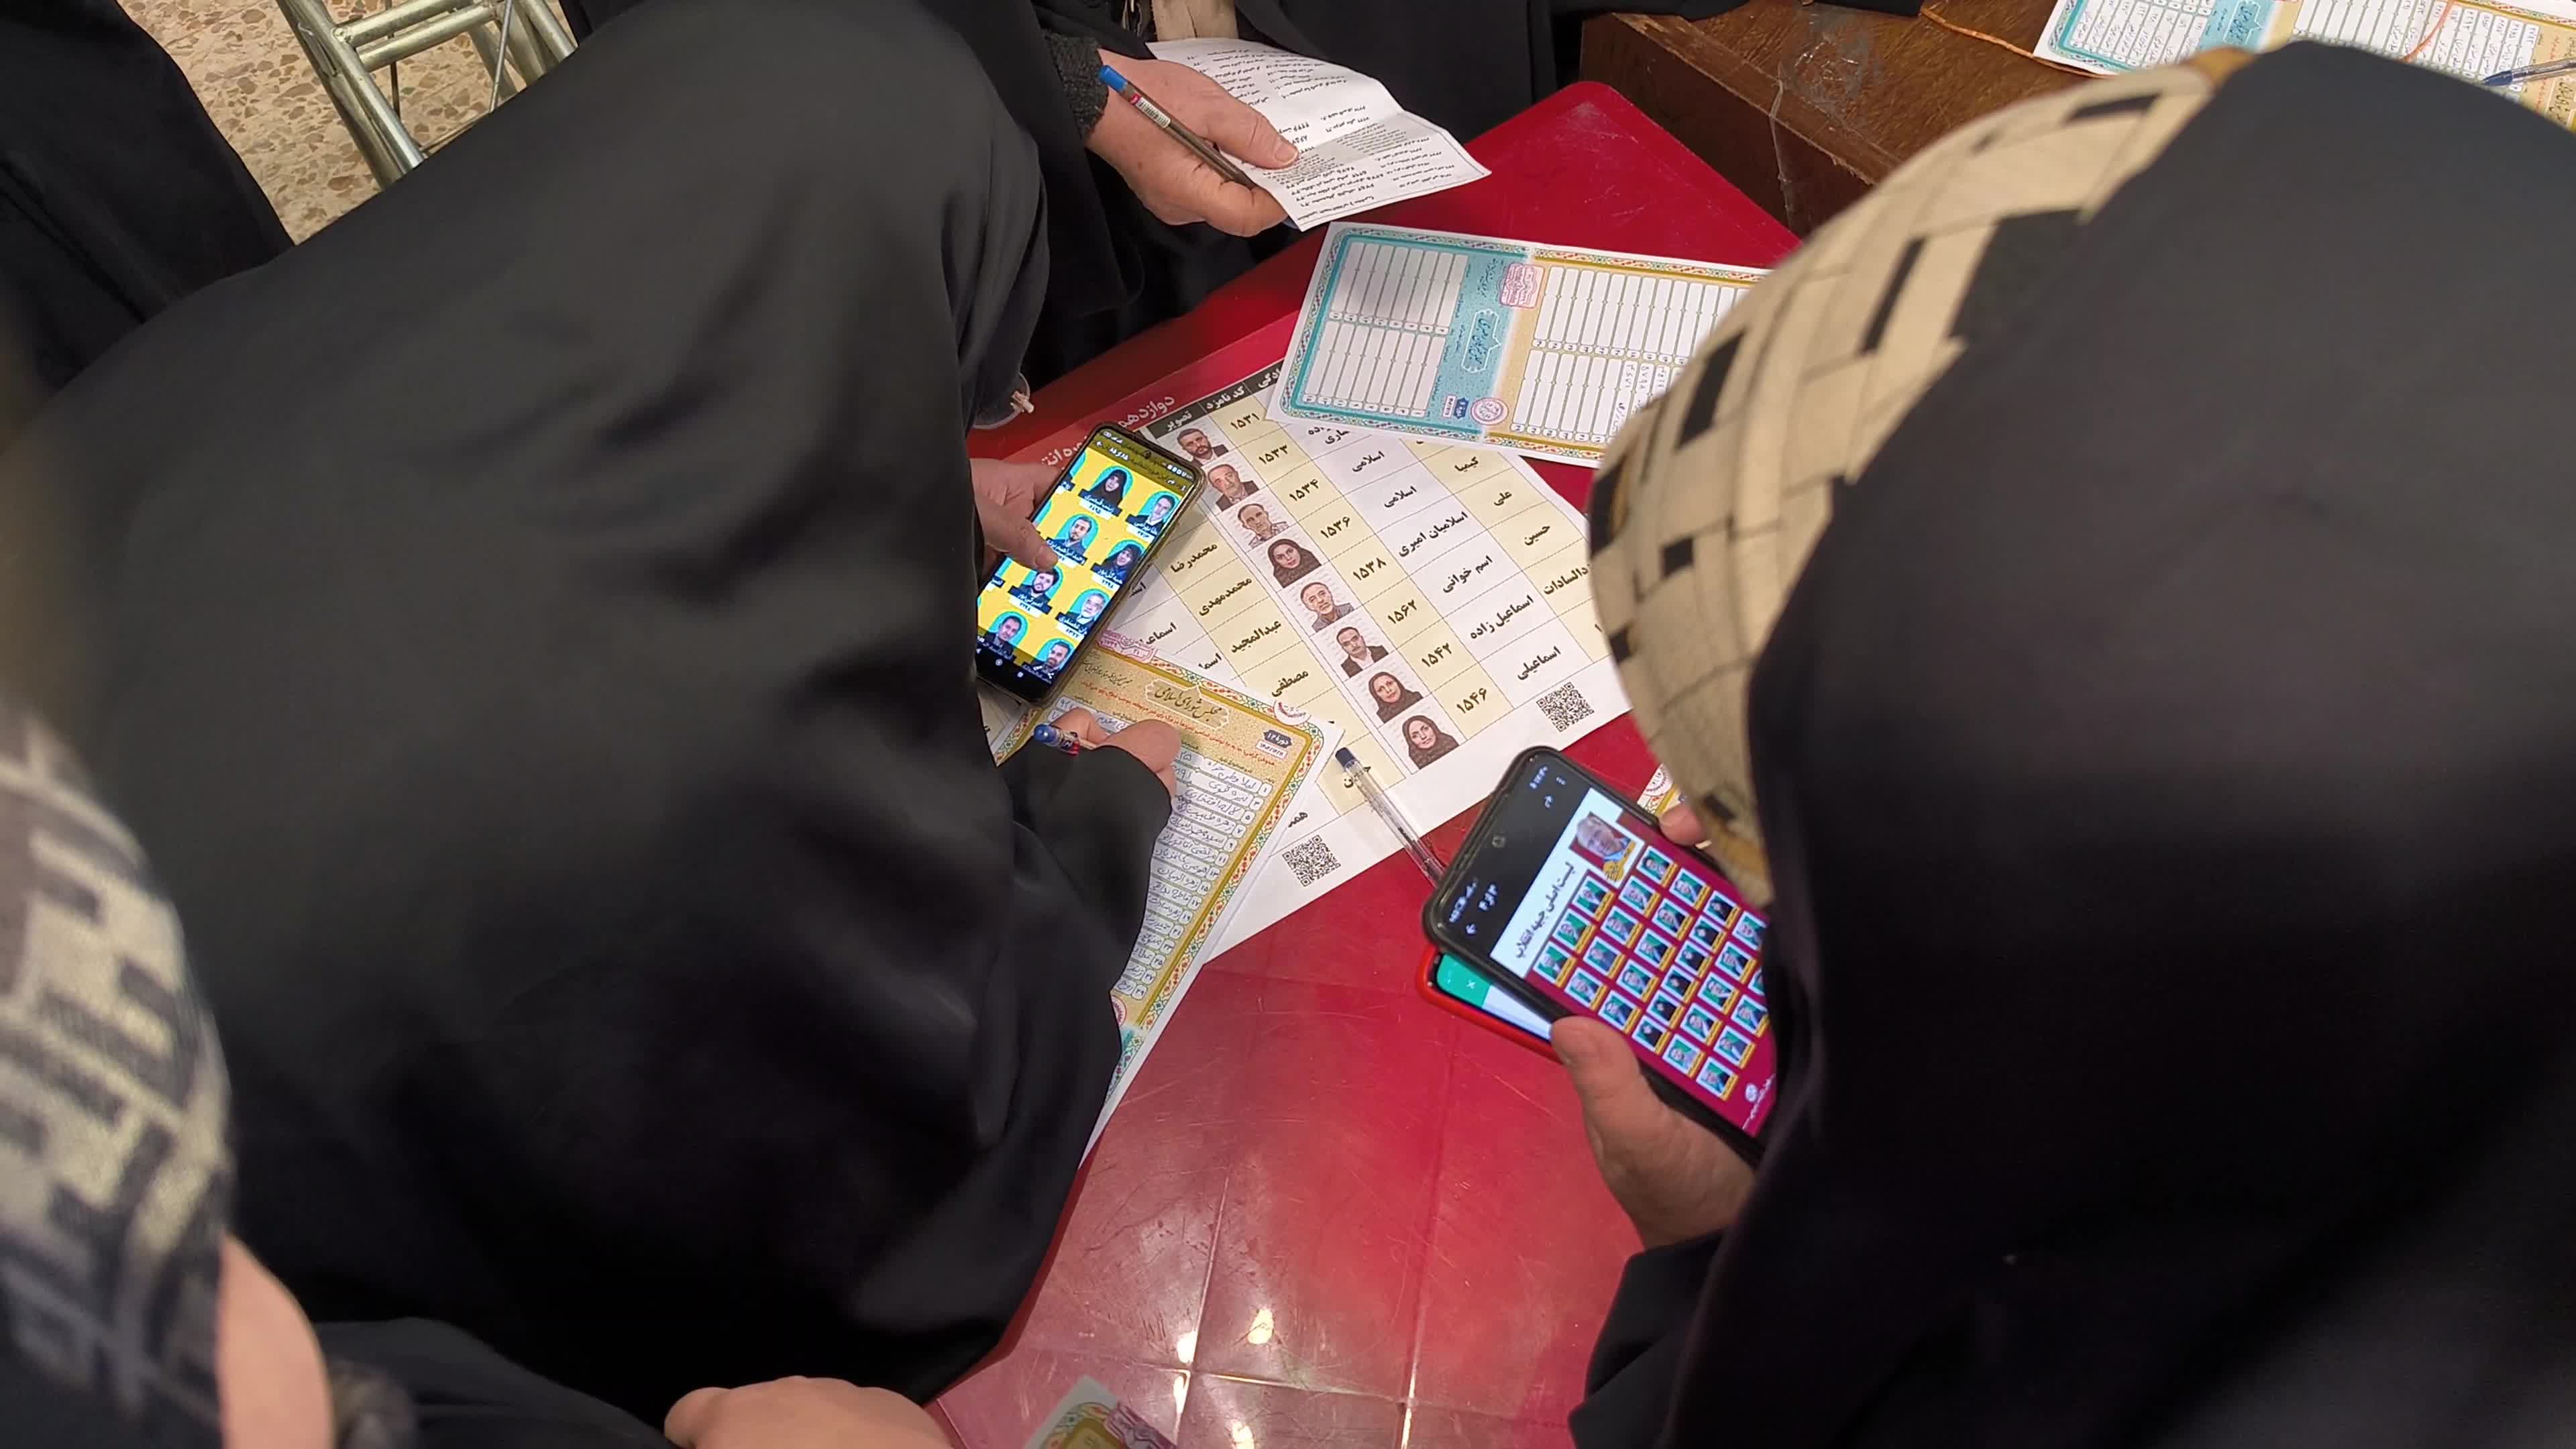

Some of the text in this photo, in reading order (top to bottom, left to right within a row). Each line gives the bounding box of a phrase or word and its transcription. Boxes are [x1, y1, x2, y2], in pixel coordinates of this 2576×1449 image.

[1231, 387, 1245, 398] کد
[1167, 411, 1192, 431] تصویر
[1230, 413, 1260, 430] ۱۵۳۱
[1352, 451, 1385, 472] اسلامی
[1289, 479, 1320, 502] ۱۵۳۴
[1384, 486, 1417, 508] اسلامی
[1493, 491, 1512, 506] علی
[1320, 517, 1351, 539] ۱۵۳۶
[1398, 511, 1468, 557] اسلامیان امیری
[1523, 525, 1550, 545] حسین
[1353, 557, 1387, 581] ۱۵۳۸
[1199, 578, 1252, 616] محمدمهدی
[1470, 594, 1534, 639] اسماعیل زاده
[1231, 619, 1282, 653] عبدالمجید
[1421, 643, 1452, 667] ۱۵۴۲
[1517, 645, 1561, 680] اسماعیلی
[1271, 669, 1309, 698] مصطفی
[1456, 686, 1488, 714] ۱۵۴۶
